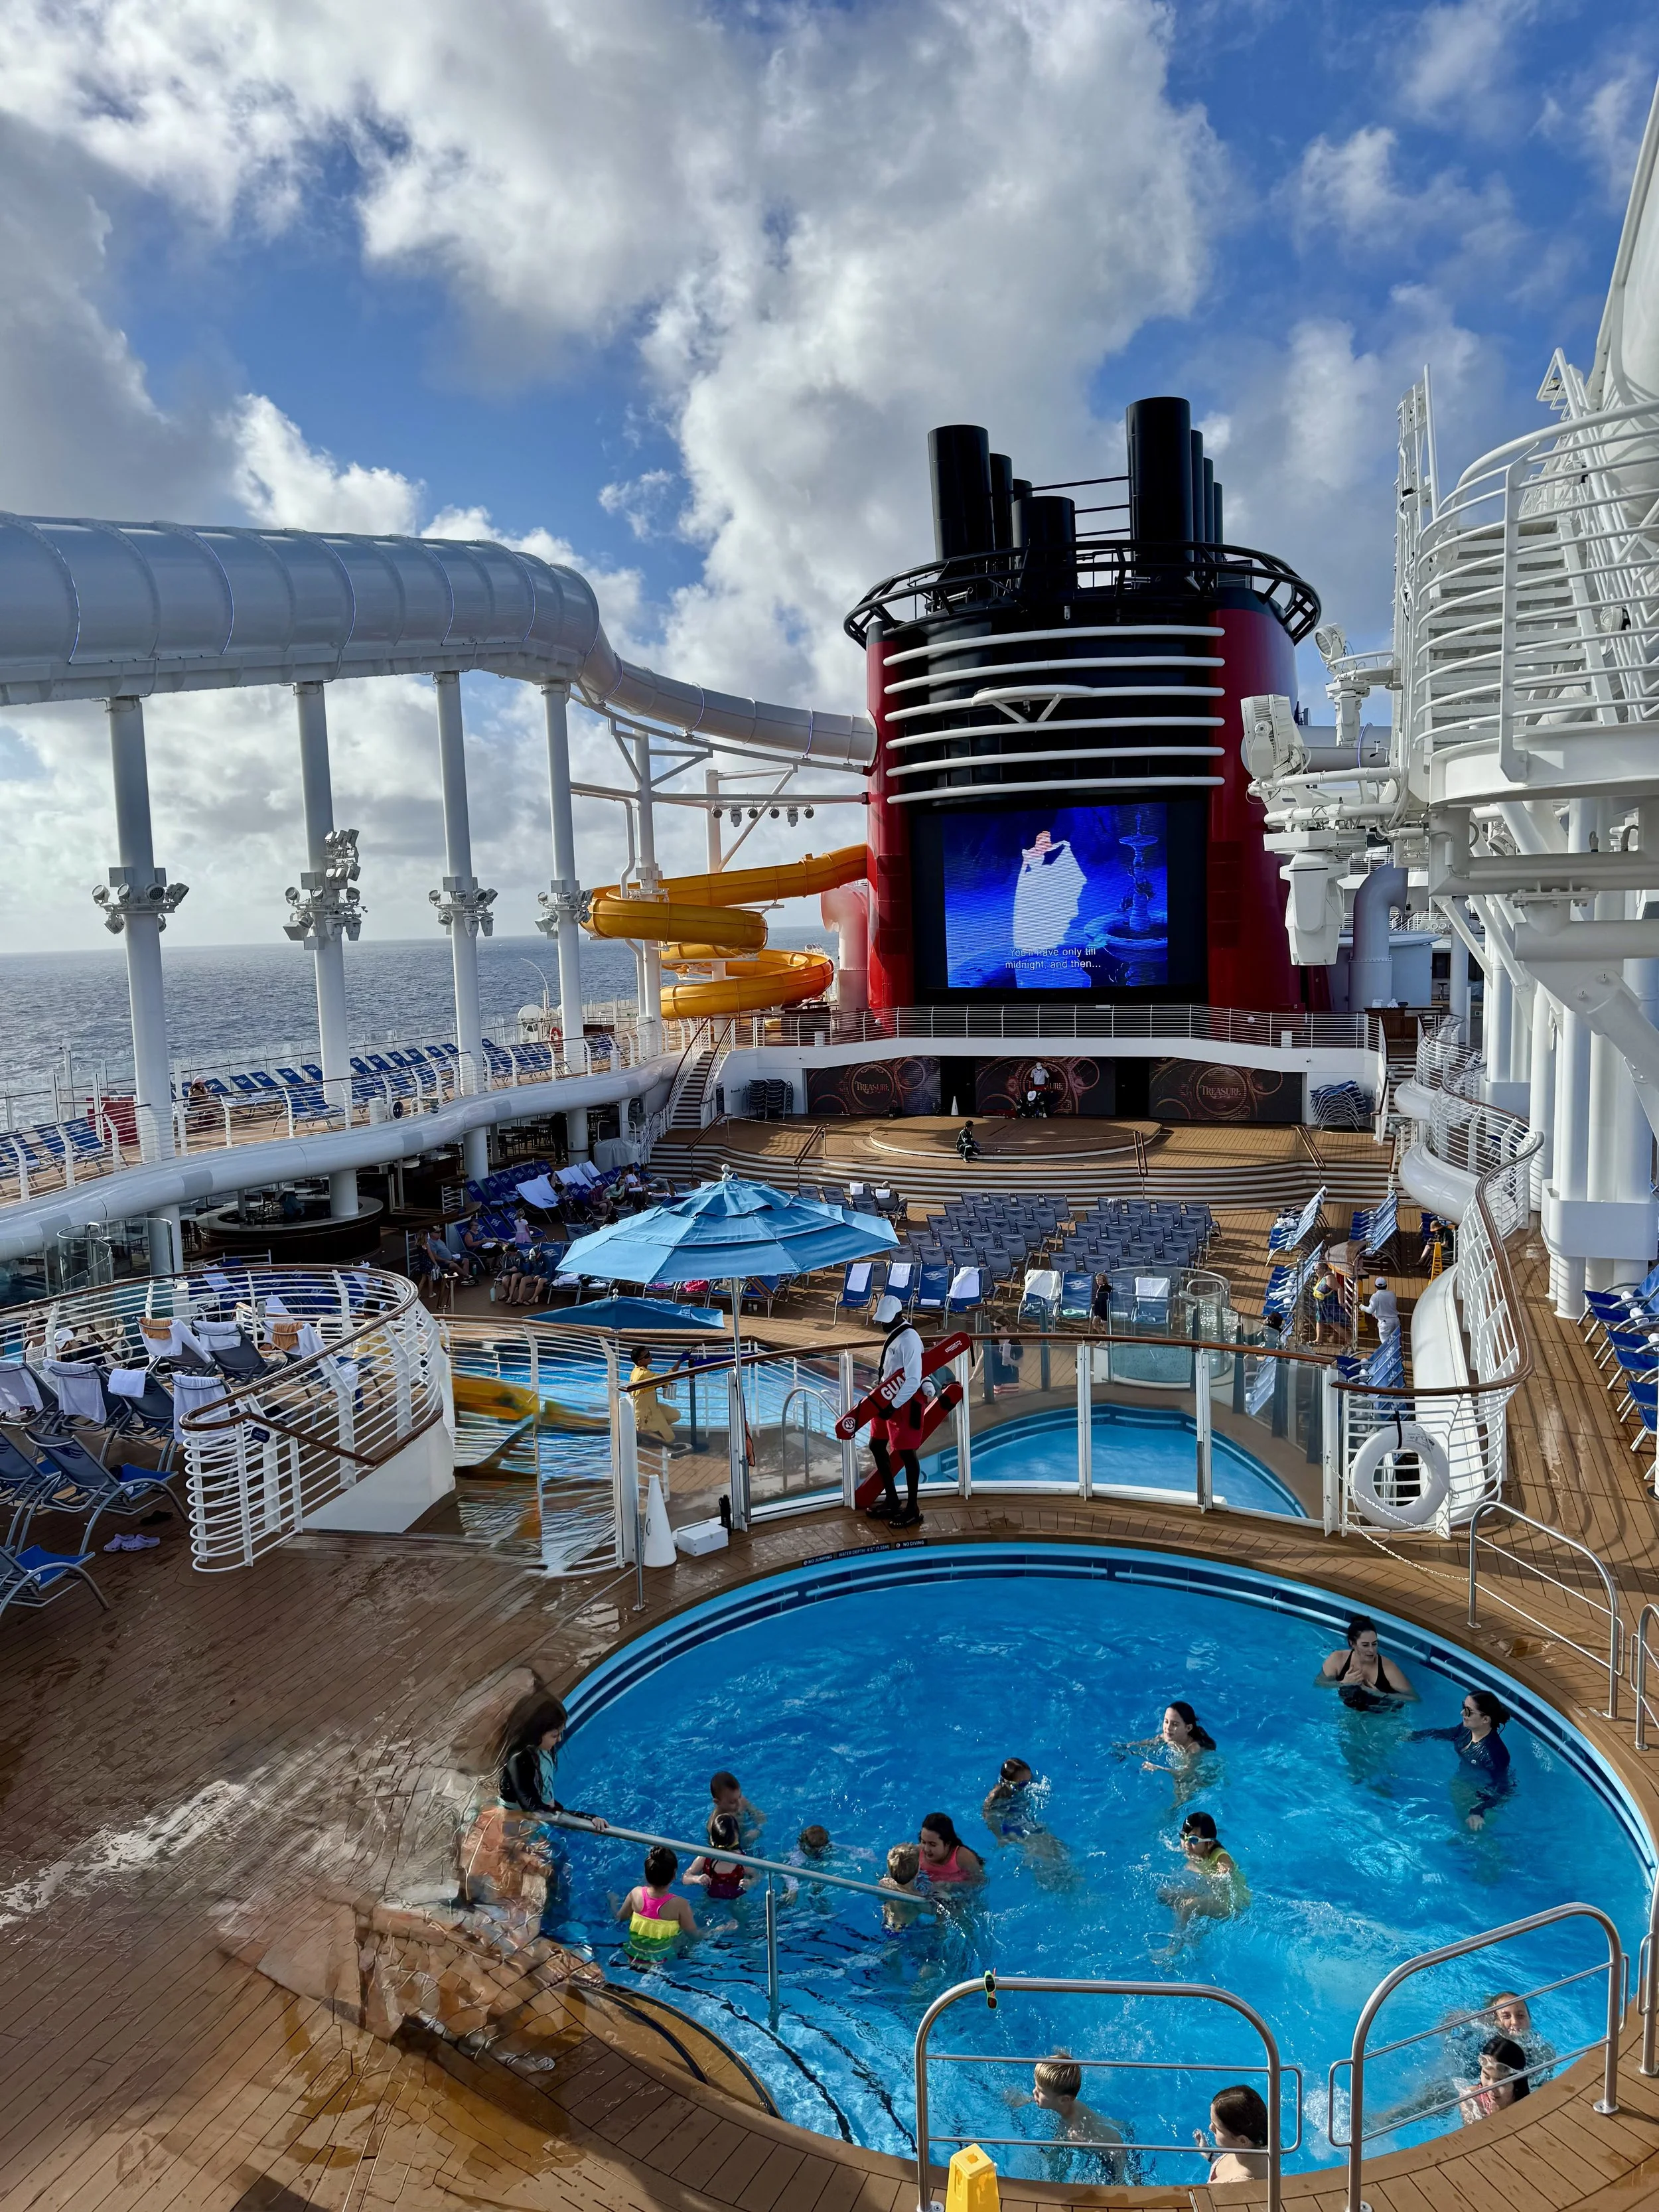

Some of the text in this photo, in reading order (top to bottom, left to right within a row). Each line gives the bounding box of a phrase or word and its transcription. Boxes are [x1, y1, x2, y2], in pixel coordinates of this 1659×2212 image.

[1009, 947, 1096, 958] You'll have only till
[1005, 960, 1046, 970] midnight,
[1070, 960, 1101, 968] then...
[1200, 1084, 1241, 1099] TREASURE
[881, 1372, 906, 1400] GUA
[815, 1554, 833, 1563] JUMPING
